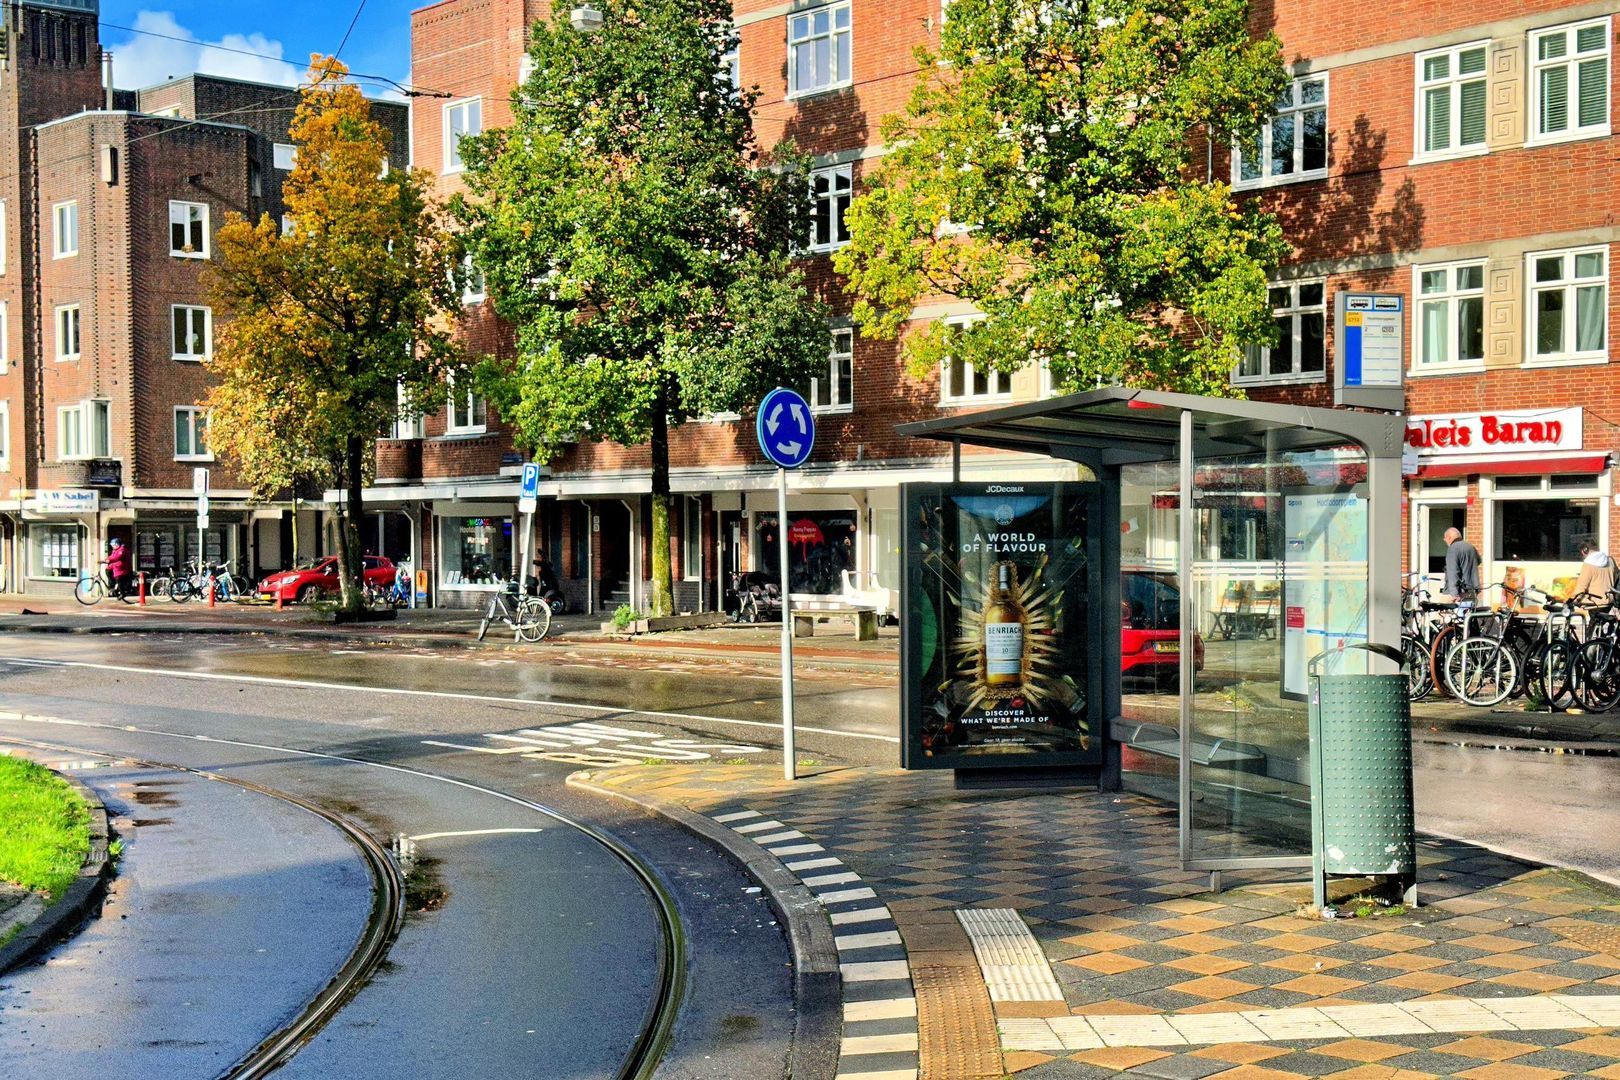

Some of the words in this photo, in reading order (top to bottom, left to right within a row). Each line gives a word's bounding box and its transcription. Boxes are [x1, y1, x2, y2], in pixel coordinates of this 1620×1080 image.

[1480, 415, 1563, 445] Baran
[525, 466, 535, 484] P
[963, 544, 980, 552] OF
[986, 544, 1046, 552] FLAVOUR
[974, 533, 982, 542] A
[988, 533, 1035, 542] WORLD
[420, 722, 664, 754] LIJN
[520, 739, 768, 767] BUS
